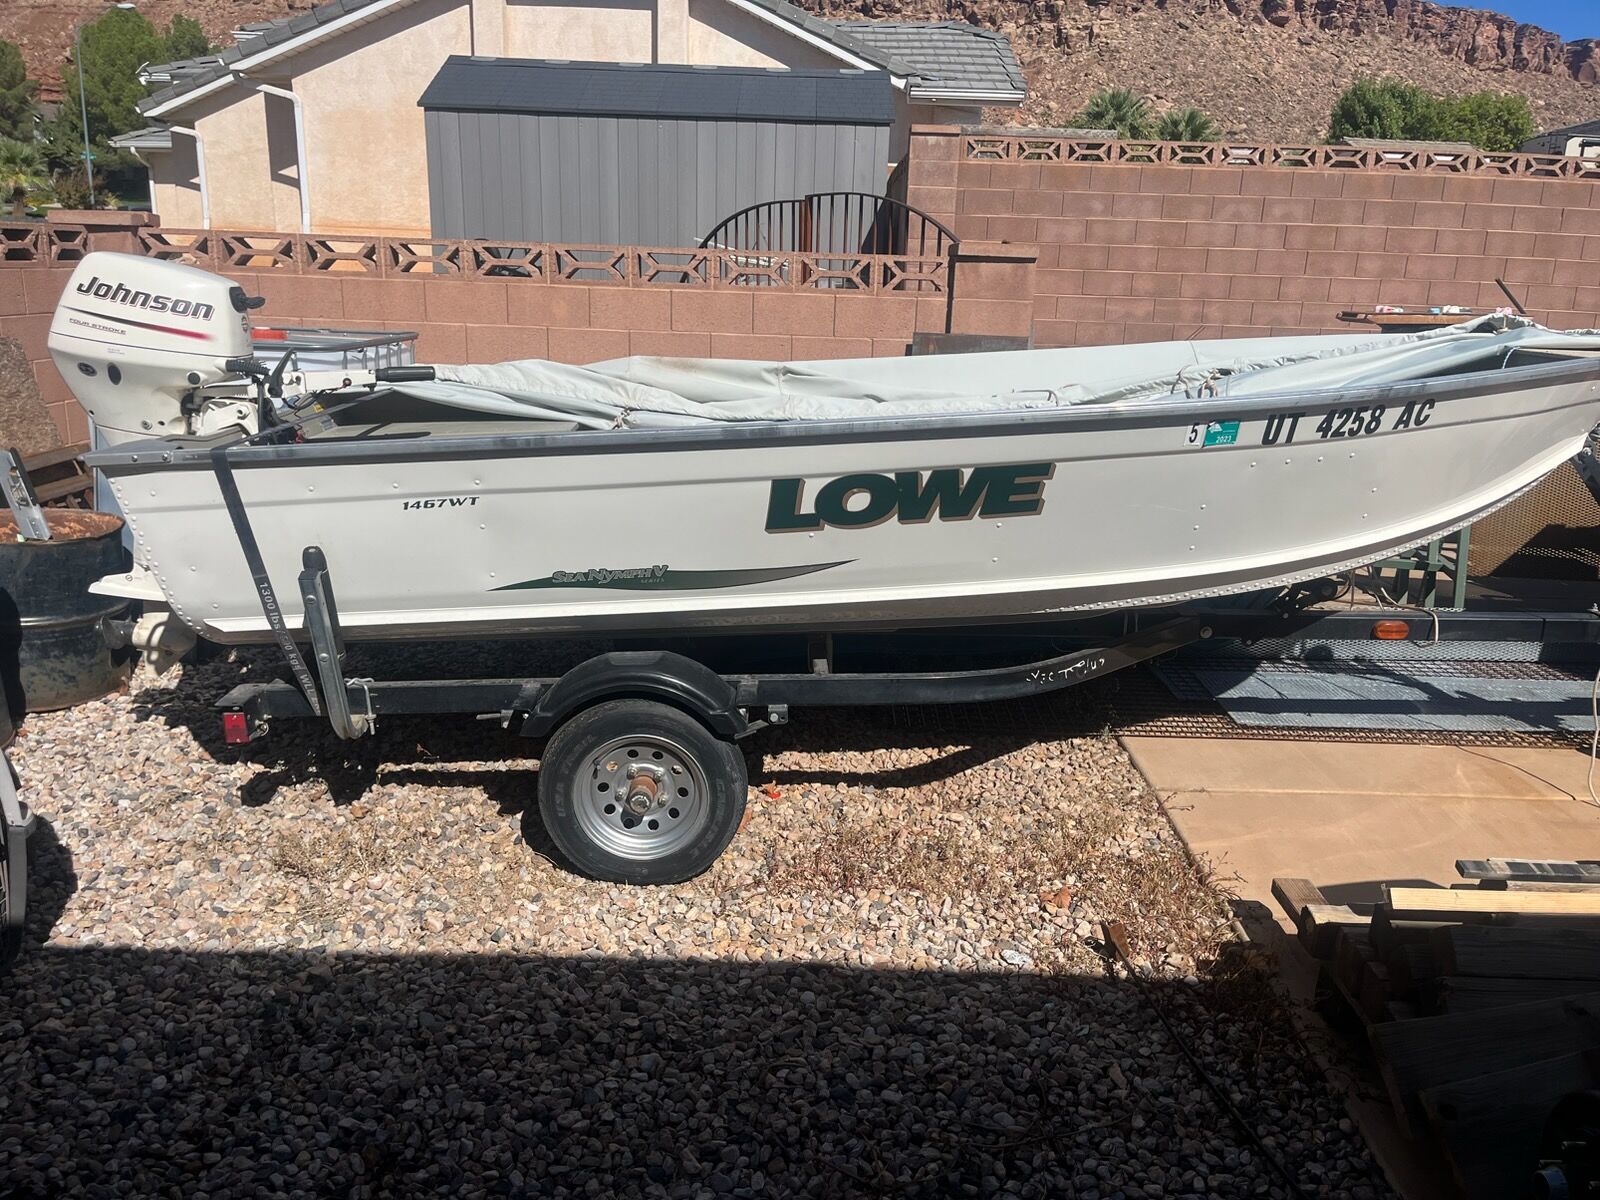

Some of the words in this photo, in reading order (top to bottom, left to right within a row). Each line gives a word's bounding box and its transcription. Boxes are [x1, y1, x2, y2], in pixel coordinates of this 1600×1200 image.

[76, 276, 215, 321] Johnson
[69, 318, 89, 327] FOUR
[91, 323, 126, 335] STROKE
[1188, 422, 1200, 443] 5
[1261, 412, 1307, 446] UT
[1315, 404, 1386, 439] 4258
[1392, 398, 1435, 430] AC
[402, 496, 480, 511] 1467WT
[765, 462, 1056, 534] LOWE
[259, 582, 275, 609] 1300
